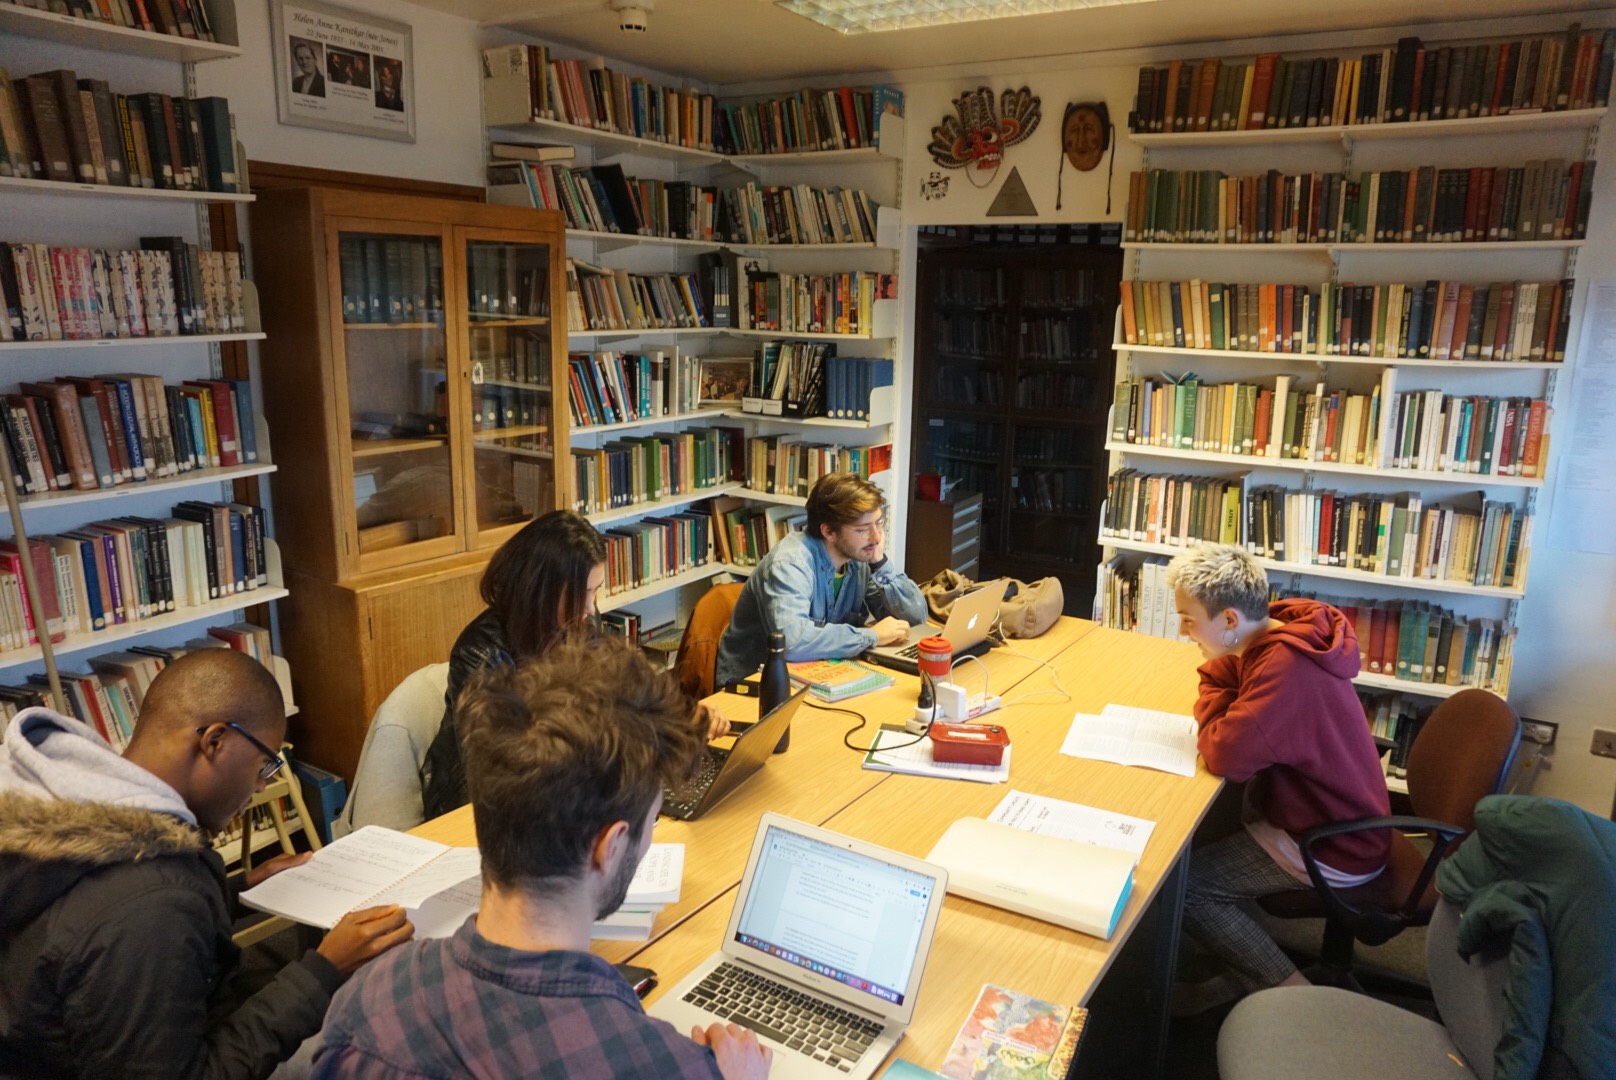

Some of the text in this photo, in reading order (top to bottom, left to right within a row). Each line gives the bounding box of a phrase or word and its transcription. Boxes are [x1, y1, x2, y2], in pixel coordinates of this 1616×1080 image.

[292, 12, 314, 25] Helen
[315, 17, 334, 29] Anne
[314, 31, 329, 41] June
[357, 41, 370, 50] May
[1505, 410, 1515, 427] NISA
[22, 415, 40, 462] PEASANT SOCIETIES
[1142, 583, 1150, 610] AFRICA
[1155, 587, 1163, 612] AFRICA
